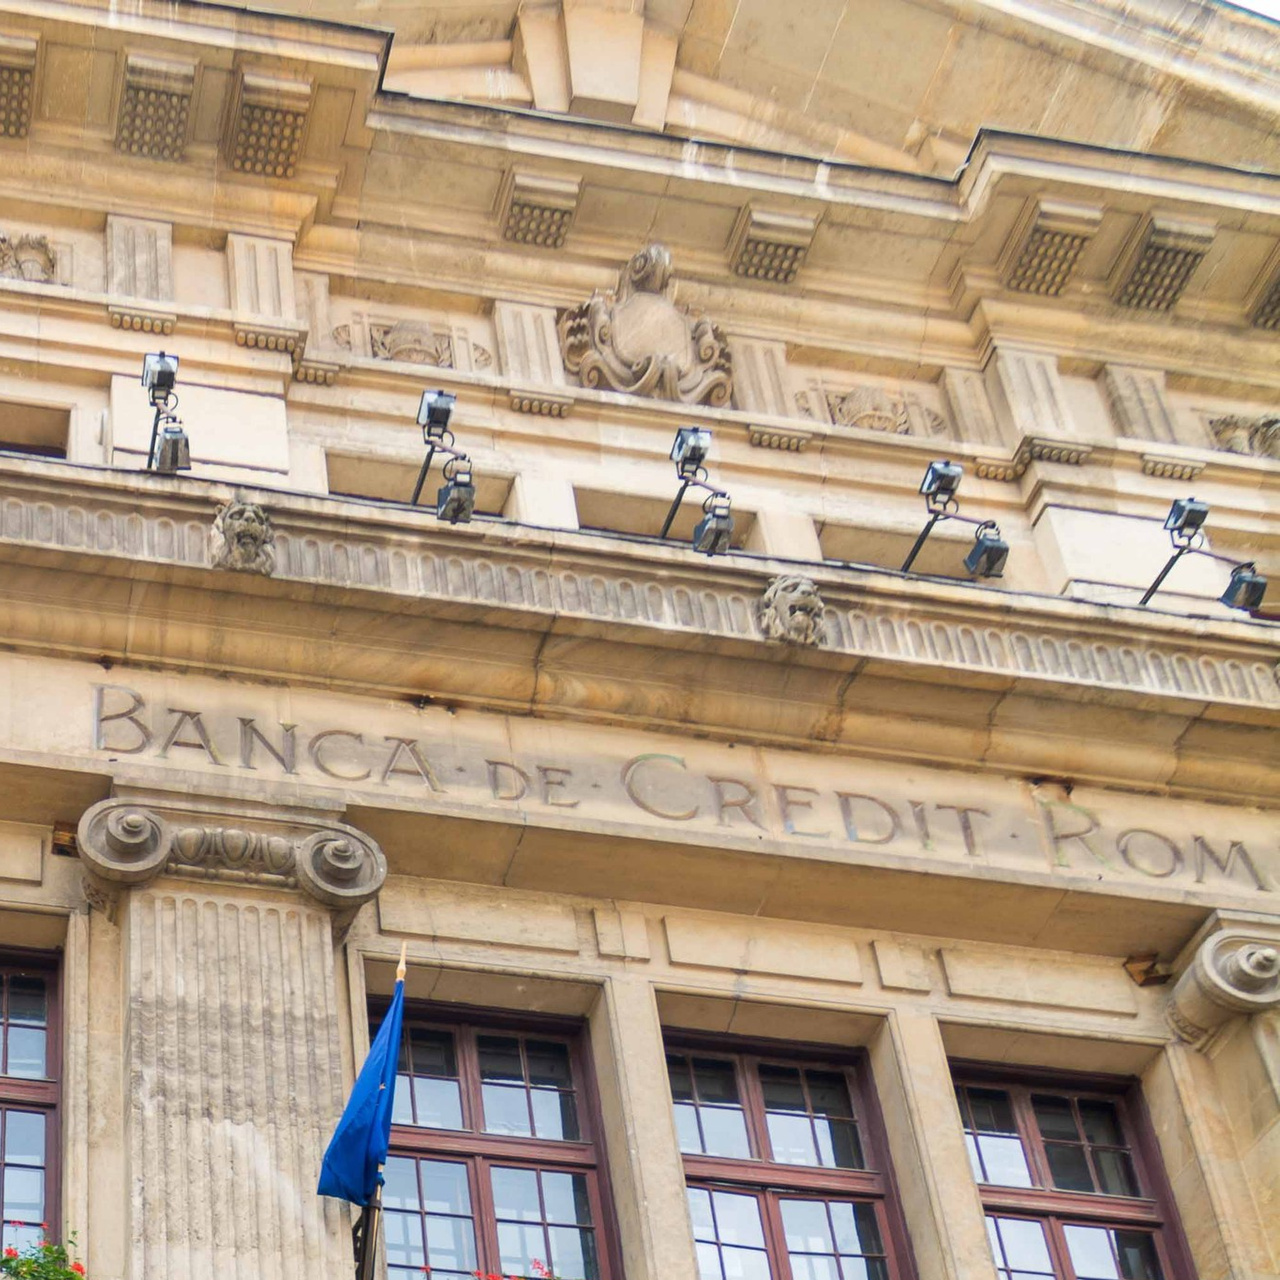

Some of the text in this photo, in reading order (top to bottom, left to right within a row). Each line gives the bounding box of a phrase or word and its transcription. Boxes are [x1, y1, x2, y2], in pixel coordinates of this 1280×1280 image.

[89, 682, 448, 793] BANCA
[485, 758, 580, 808] DE
[622, 753, 991, 857] CREDIT
